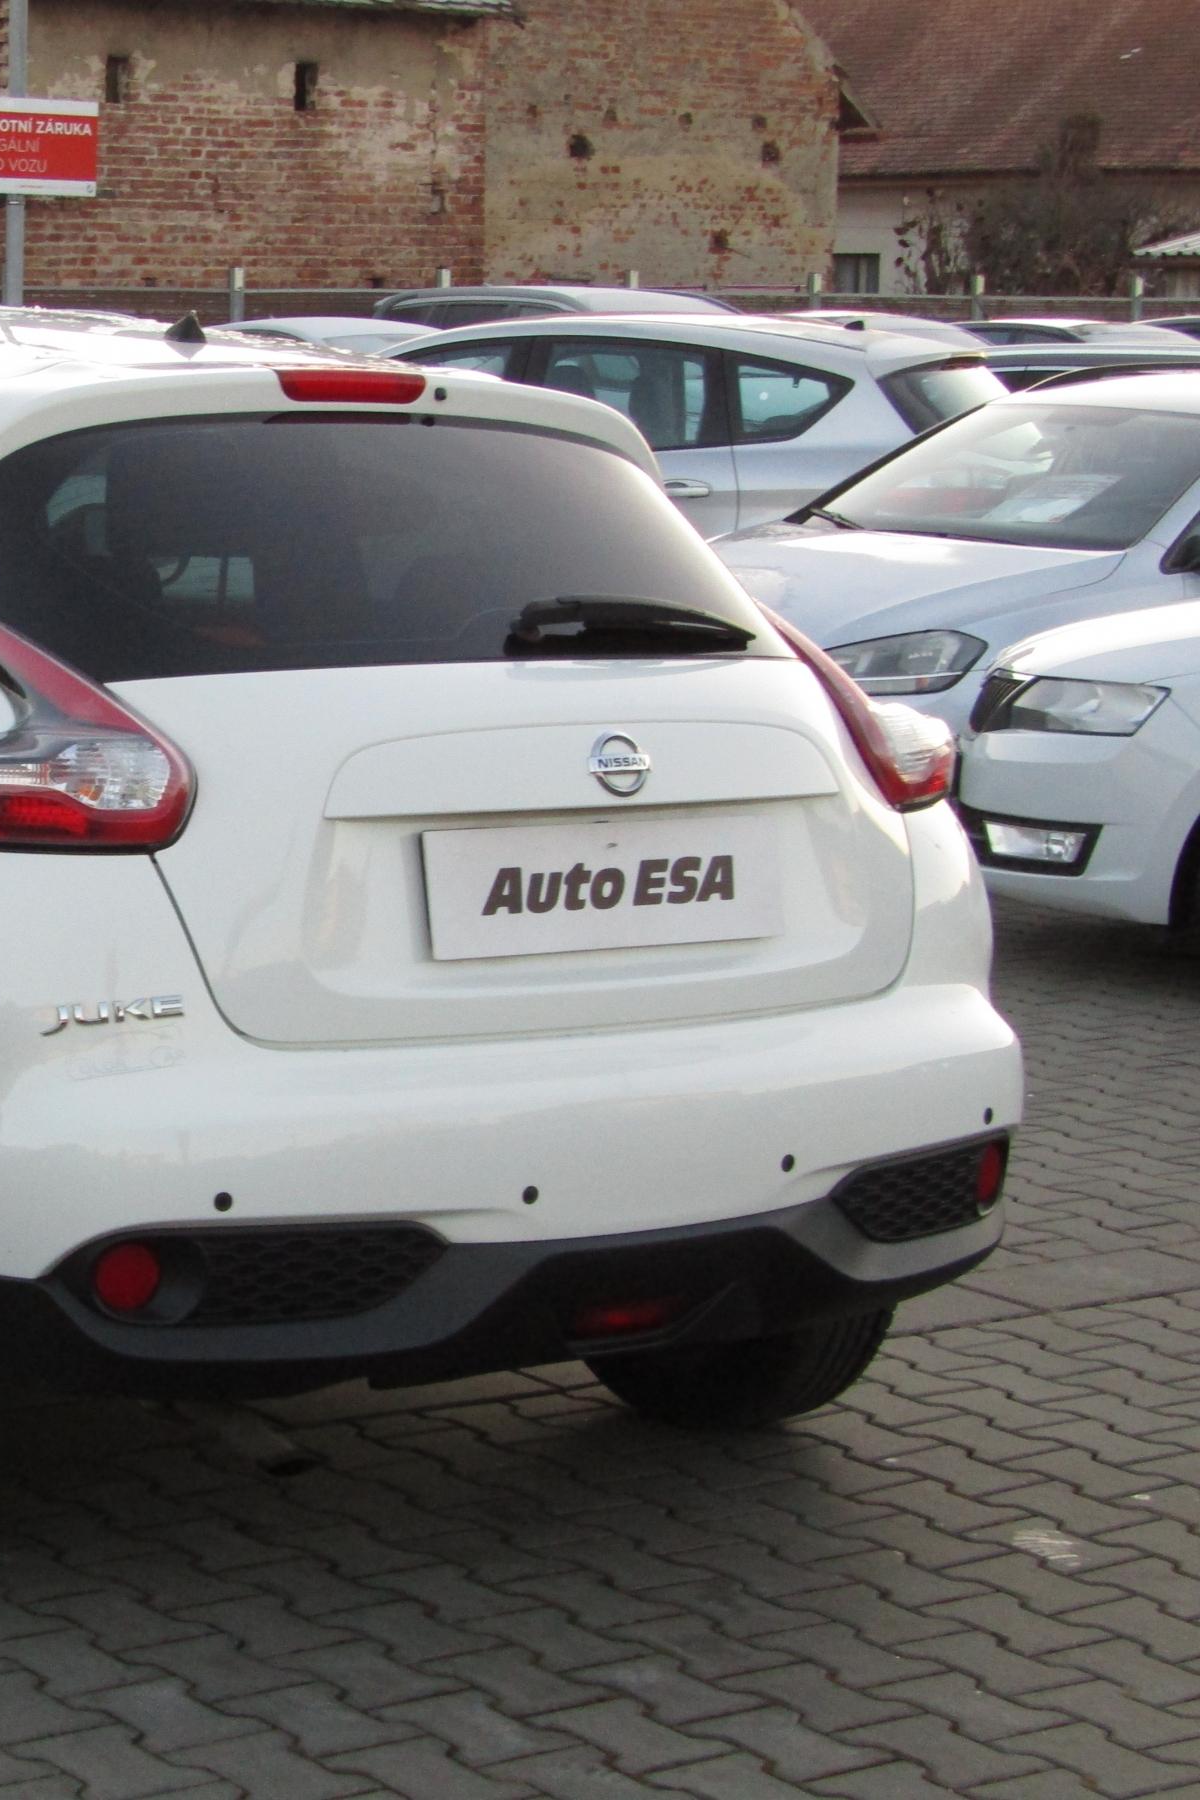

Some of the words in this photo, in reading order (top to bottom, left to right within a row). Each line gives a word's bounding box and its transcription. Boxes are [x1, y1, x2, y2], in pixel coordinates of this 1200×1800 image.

[35, 118, 92, 136] ZÁRUKA
[7, 158, 47, 173] VOZU
[597, 757, 647, 769] NISSAN
[481, 862, 625, 916] Auto
[632, 855, 735, 906] ESA
[40, 994, 185, 1037] JUKE
